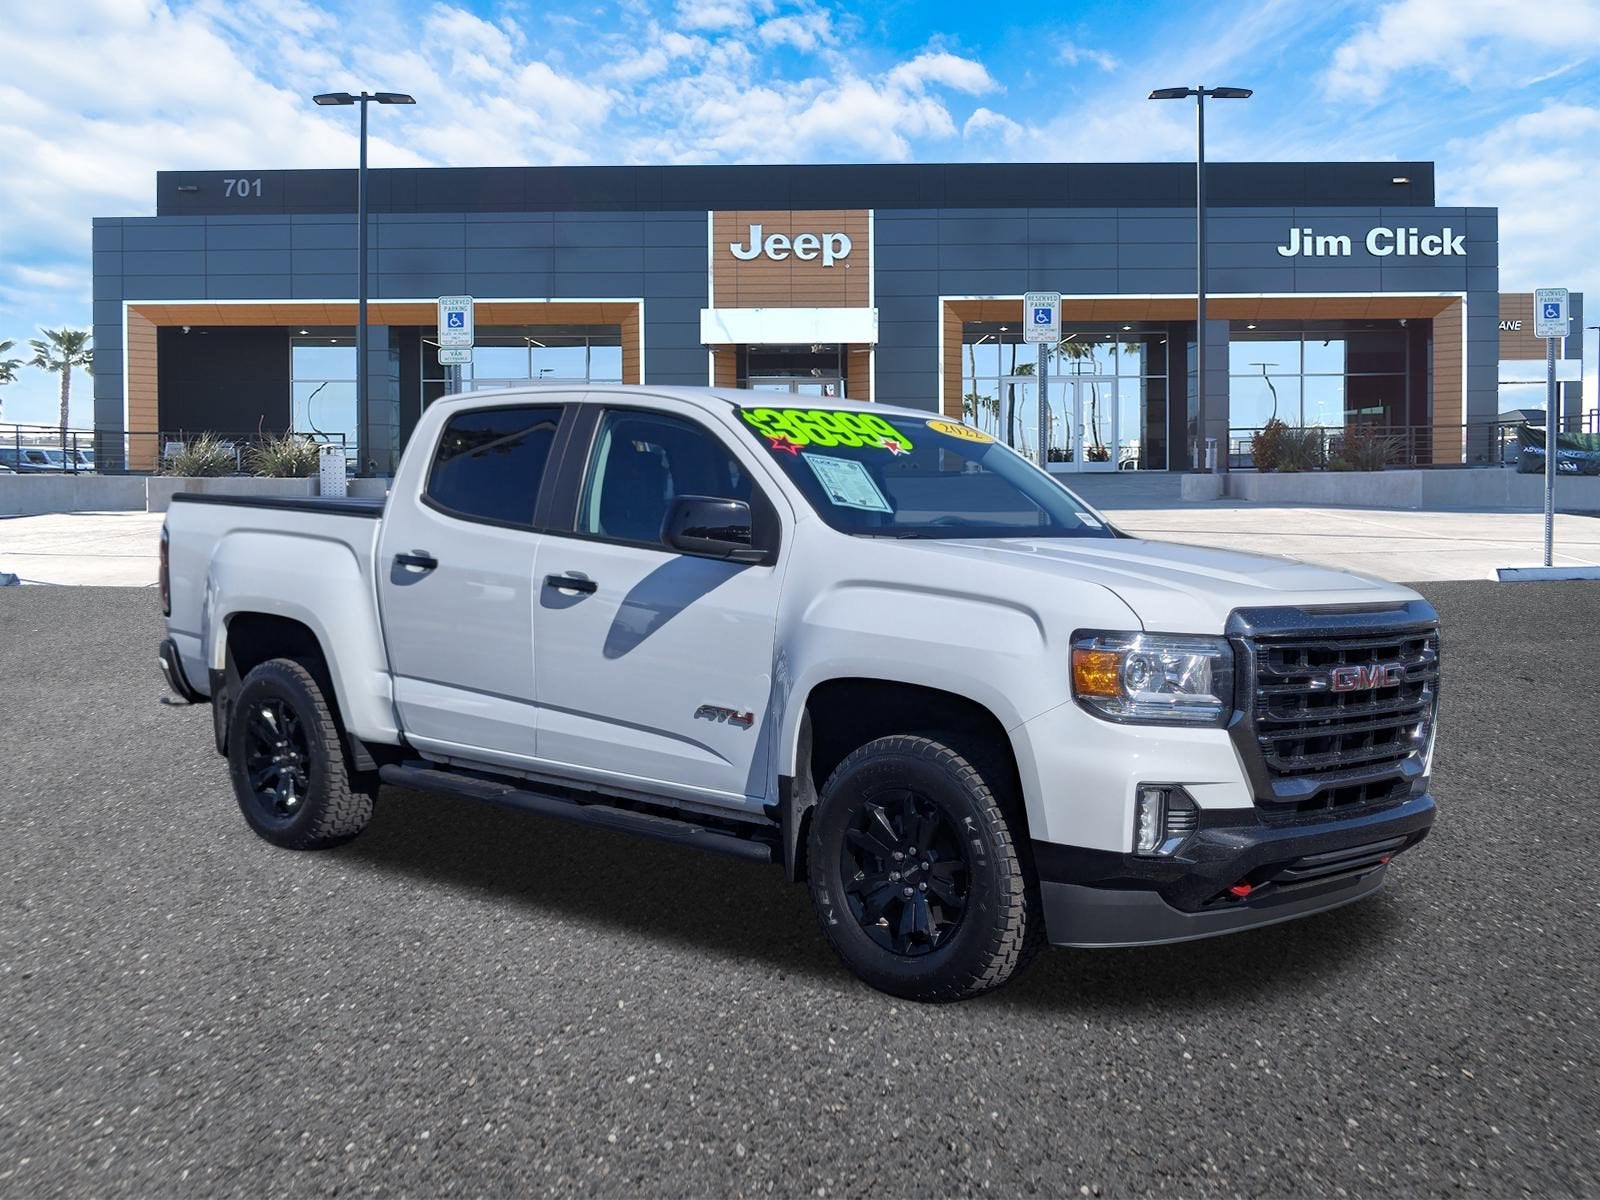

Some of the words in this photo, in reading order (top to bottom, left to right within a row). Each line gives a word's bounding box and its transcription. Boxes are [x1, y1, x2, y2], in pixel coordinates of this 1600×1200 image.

[224, 178, 262, 197] 701
[730, 224, 852, 267] Jeep
[1277, 228, 1352, 257] Jim
[1365, 227, 1467, 256] Click
[938, 423, 983, 440] 2022
[1332, 663, 1402, 692] GMC
